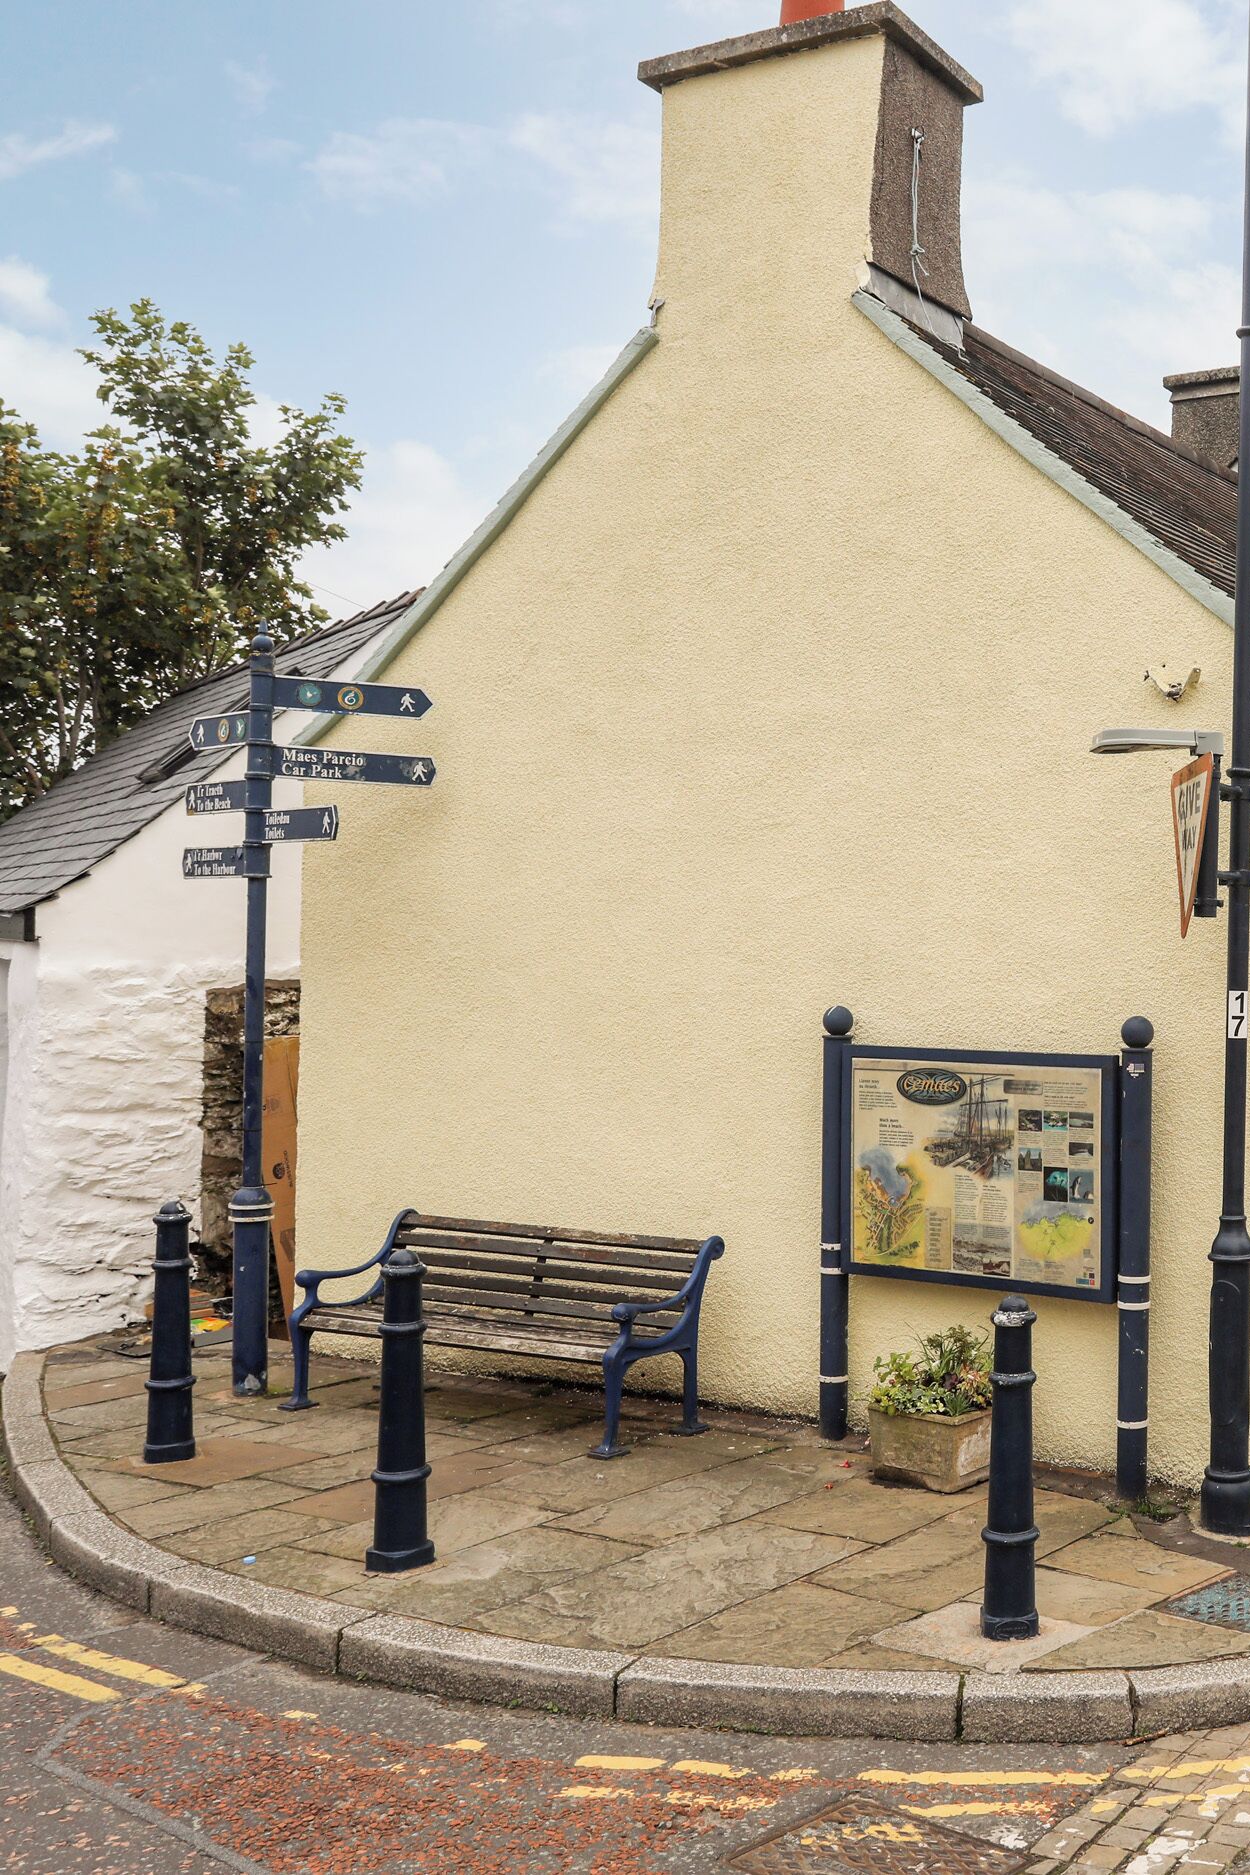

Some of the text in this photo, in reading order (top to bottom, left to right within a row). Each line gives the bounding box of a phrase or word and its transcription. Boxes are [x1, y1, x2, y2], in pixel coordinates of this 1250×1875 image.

[282, 749, 364, 766] Maes Parcio
[281, 763, 342, 778] Car Park
[205, 784, 223, 797] Traeth
[197, 797, 231, 811] To the Beach
[1178, 780, 1200, 820] GIVE
[264, 812, 290, 826] Toiledau
[264, 826, 285, 840] Toilets
[1182, 826, 1196, 852] WAY
[194, 863, 236, 875] To the Harbour
[904, 1075, 961, 1093] Cemaes
